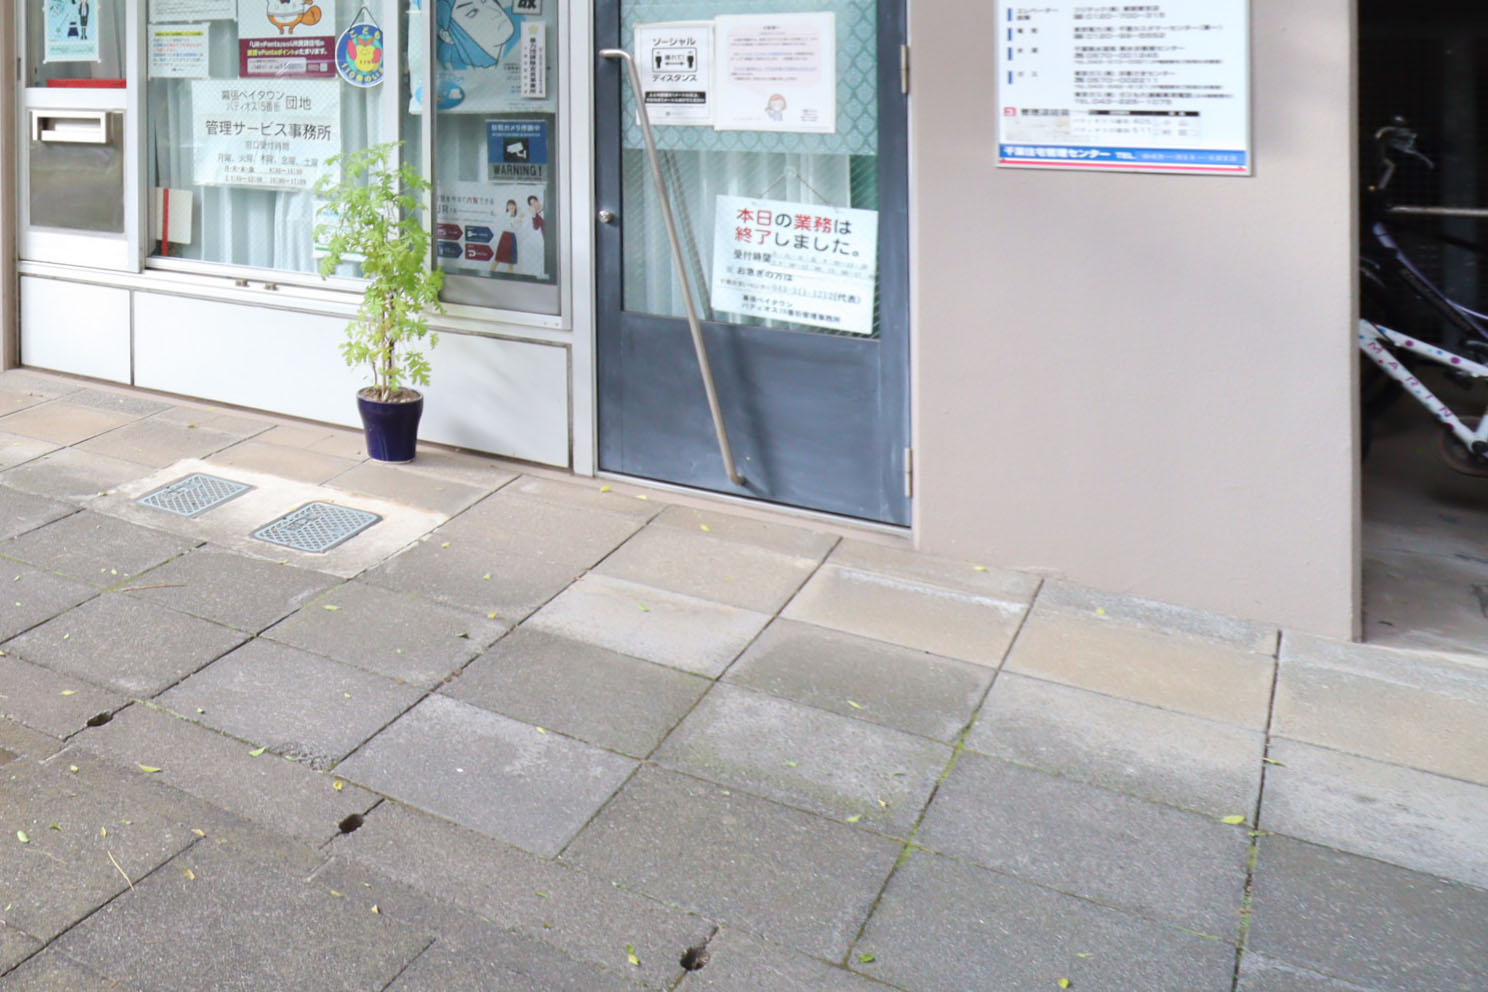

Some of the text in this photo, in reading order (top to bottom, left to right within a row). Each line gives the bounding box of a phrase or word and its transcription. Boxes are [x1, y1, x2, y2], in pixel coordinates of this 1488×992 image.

[653, 37, 697, 46] ソーシャル
[652, 74, 697, 82] ディスタンス
[285, 95, 312, 111] 団地
[206, 119, 332, 141] 管理サービス事務所
[735, 207, 853, 236] 本日の業務は
[734, 226, 860, 258] 終了しました。
